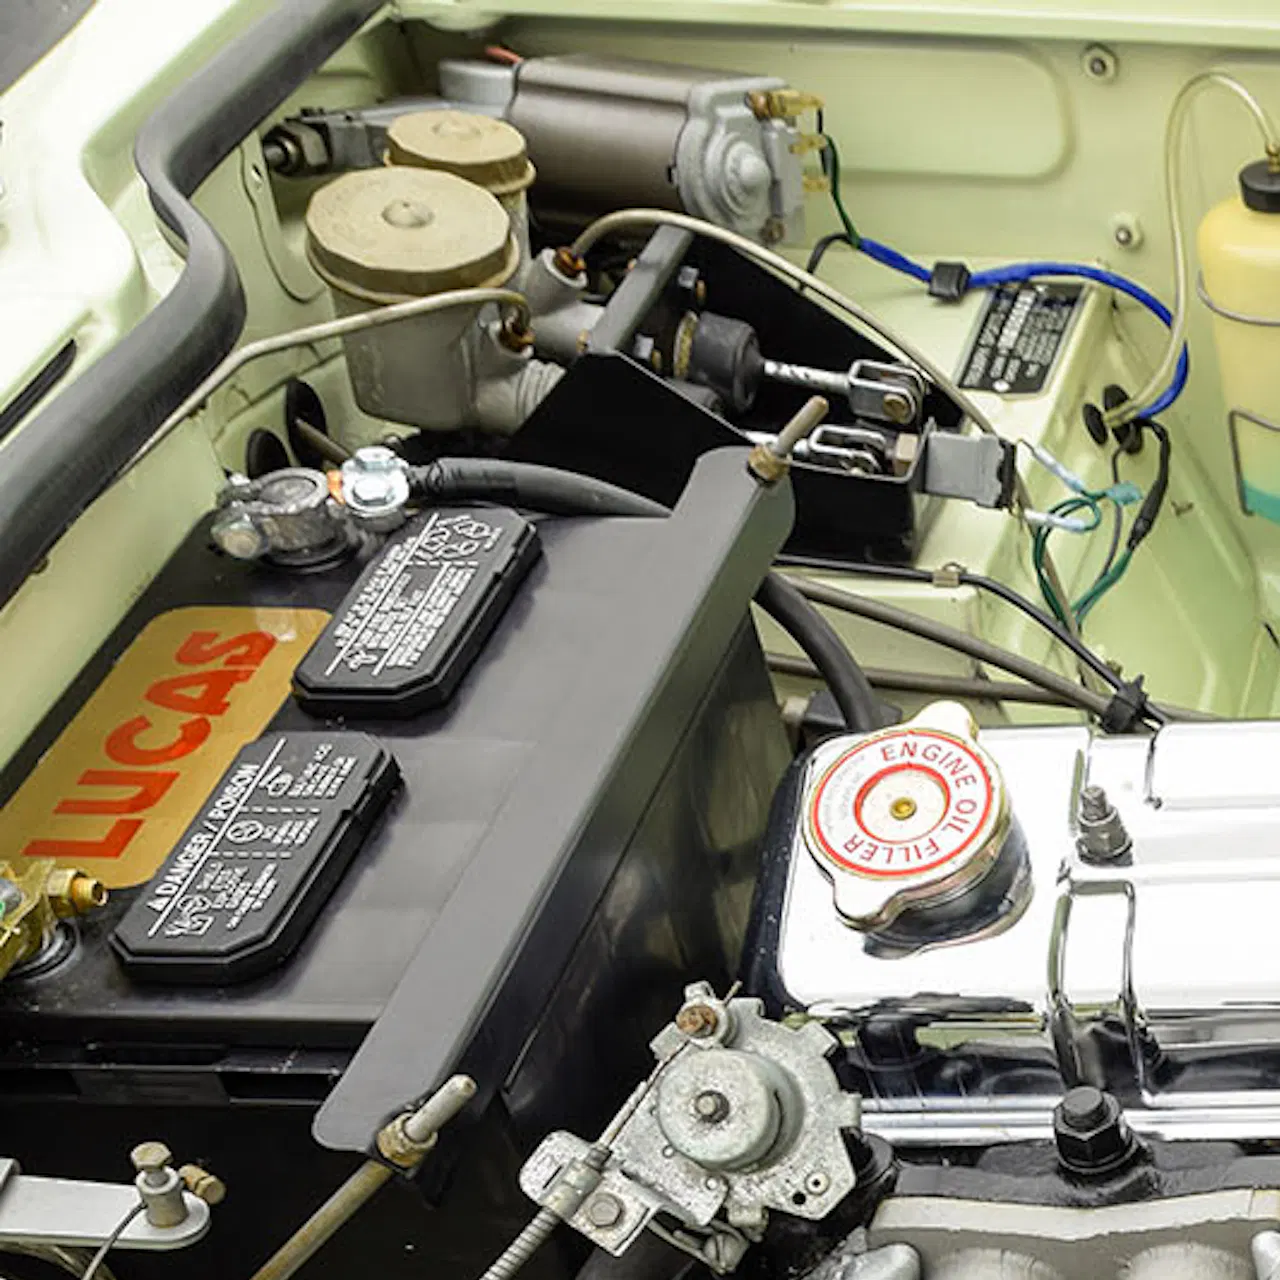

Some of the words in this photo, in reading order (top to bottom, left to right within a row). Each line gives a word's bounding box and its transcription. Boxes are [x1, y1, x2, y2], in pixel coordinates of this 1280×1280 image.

[24, 630, 278, 860] LUCAS
[880, 741, 977, 788] ENGINE
[155, 829, 214, 896] DANGER
[207, 764, 260, 820] POISON
[942, 798, 977, 834] OIL
[843, 833, 940, 864] FILLER
